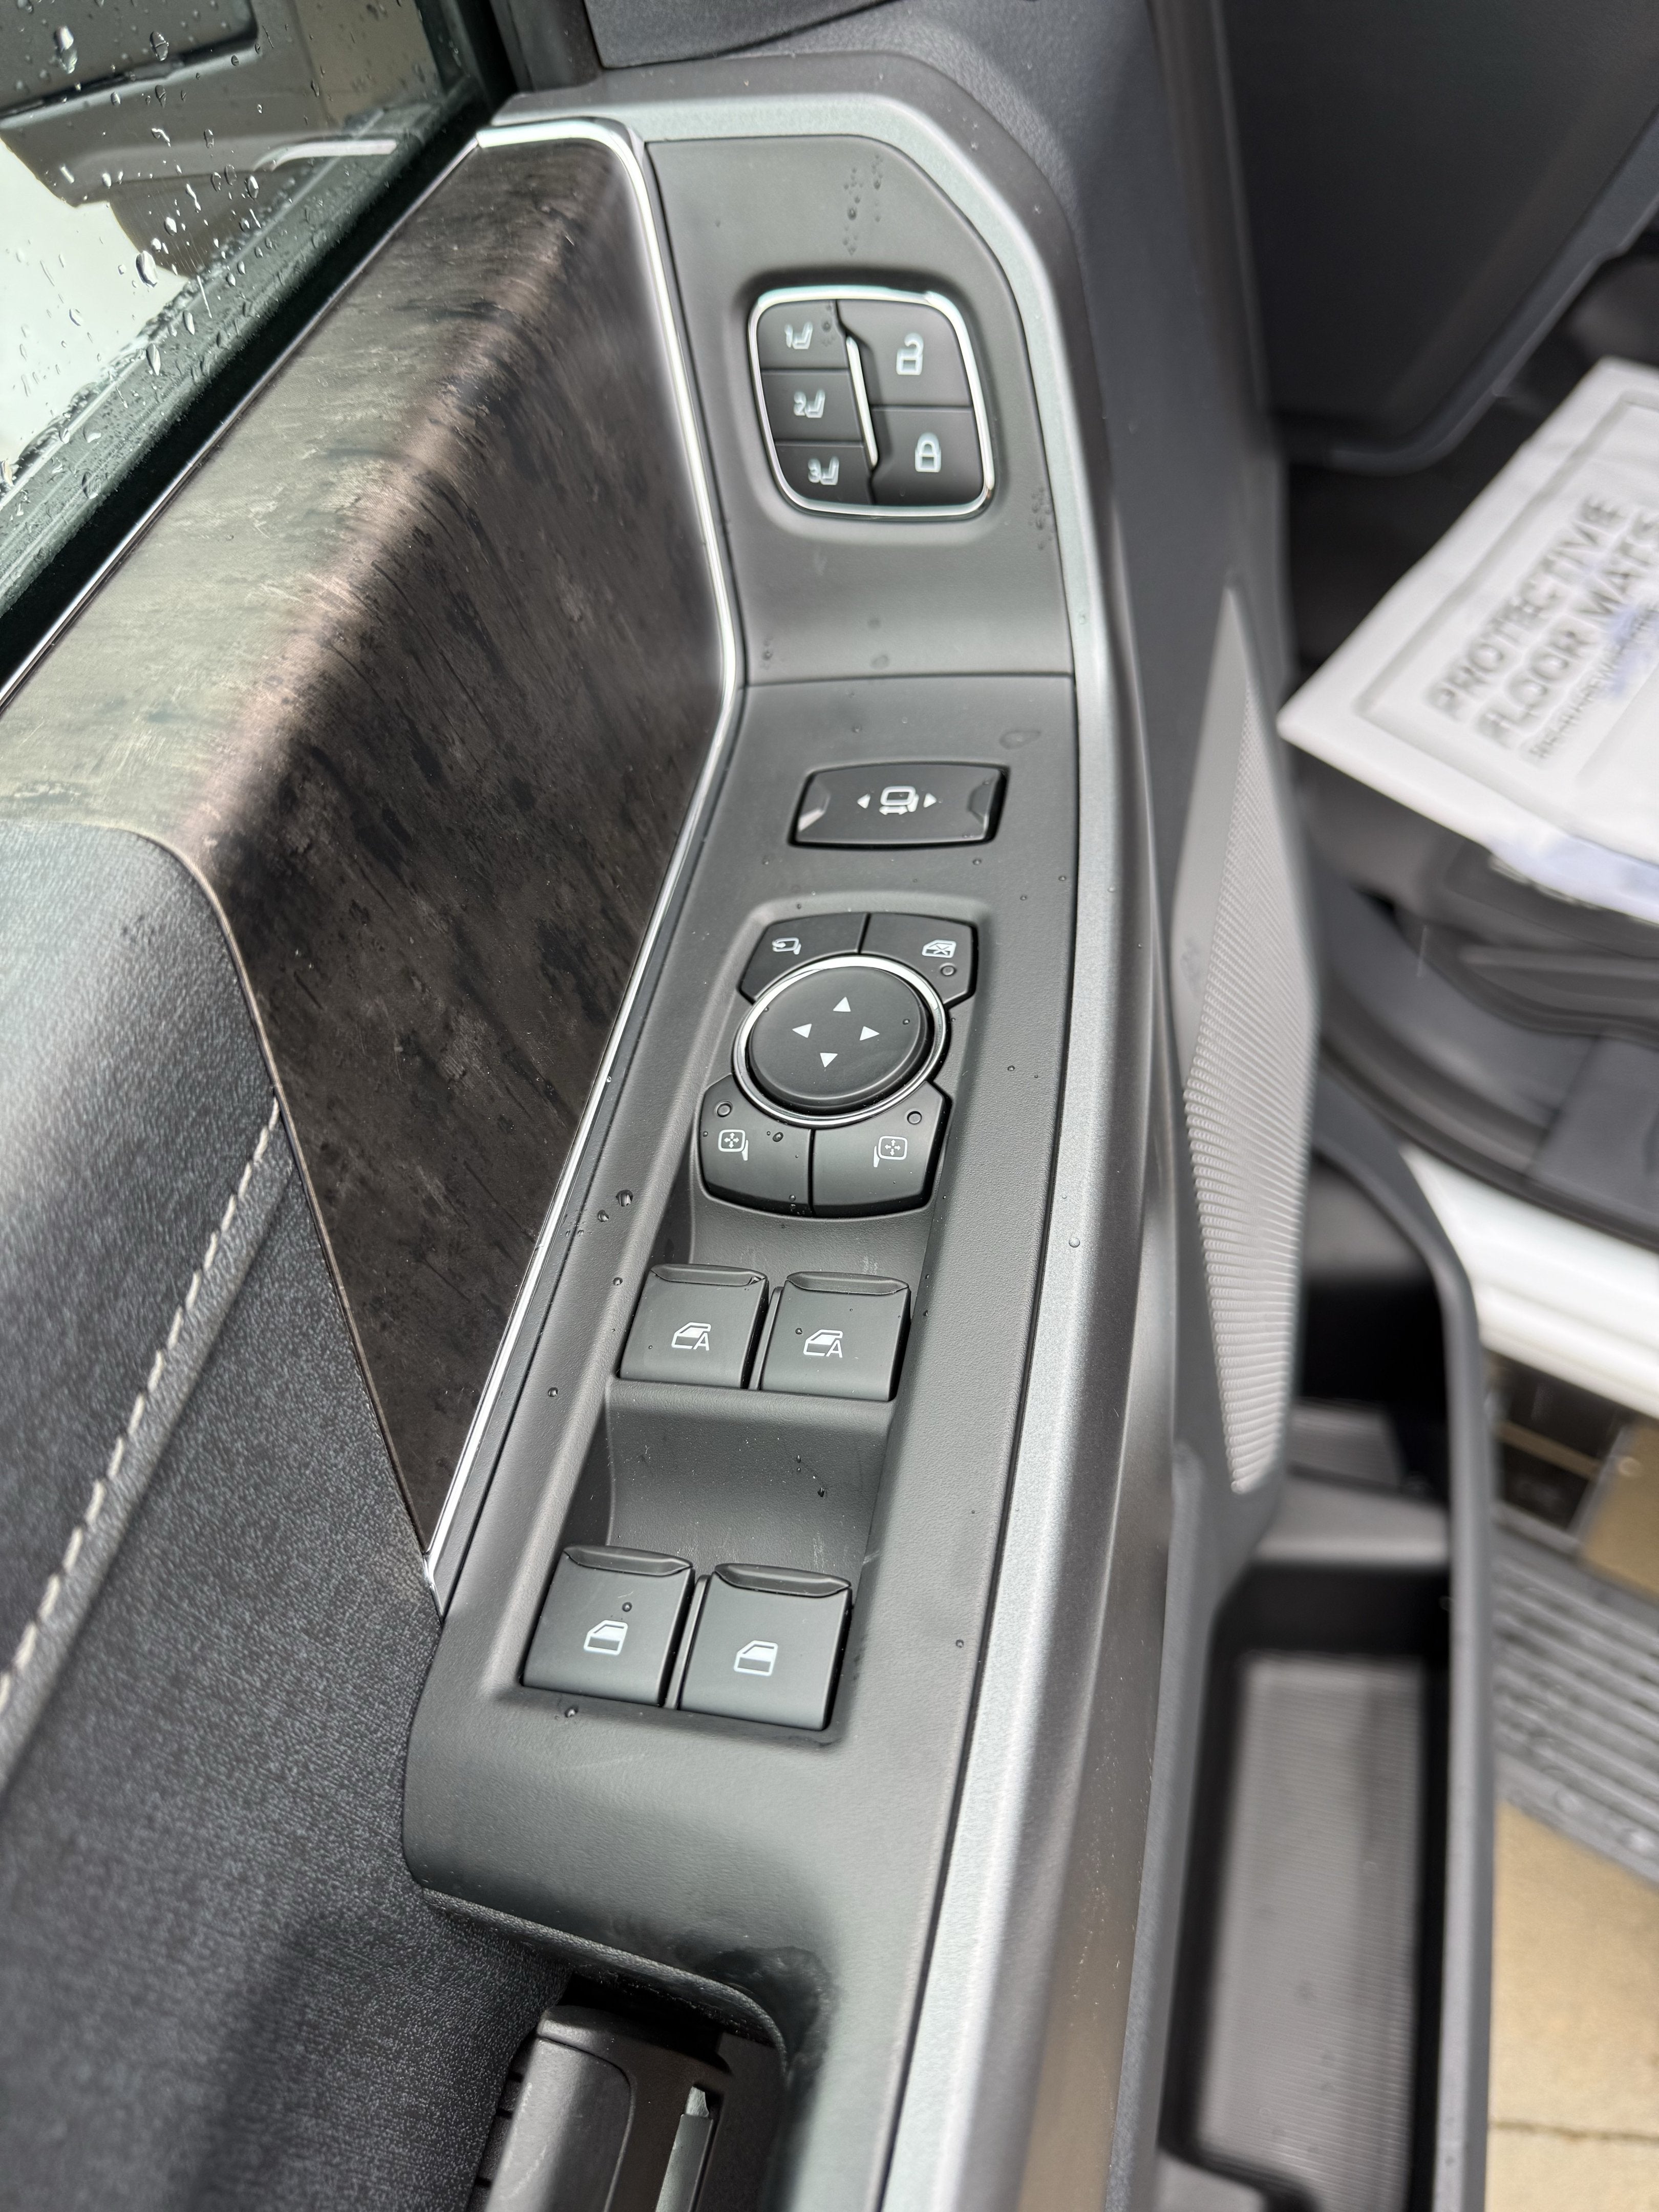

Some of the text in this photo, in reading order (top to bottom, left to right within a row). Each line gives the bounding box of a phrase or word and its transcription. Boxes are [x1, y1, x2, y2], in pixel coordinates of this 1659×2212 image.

[794, 391, 806, 416] 2
[808, 458, 821, 483] 3
[1427, 495, 1624, 721] PROTECTIVE
[1471, 626, 1598, 748] FLOOR
[693, 1333, 710, 1351] A
[826, 1339, 843, 1357] A
